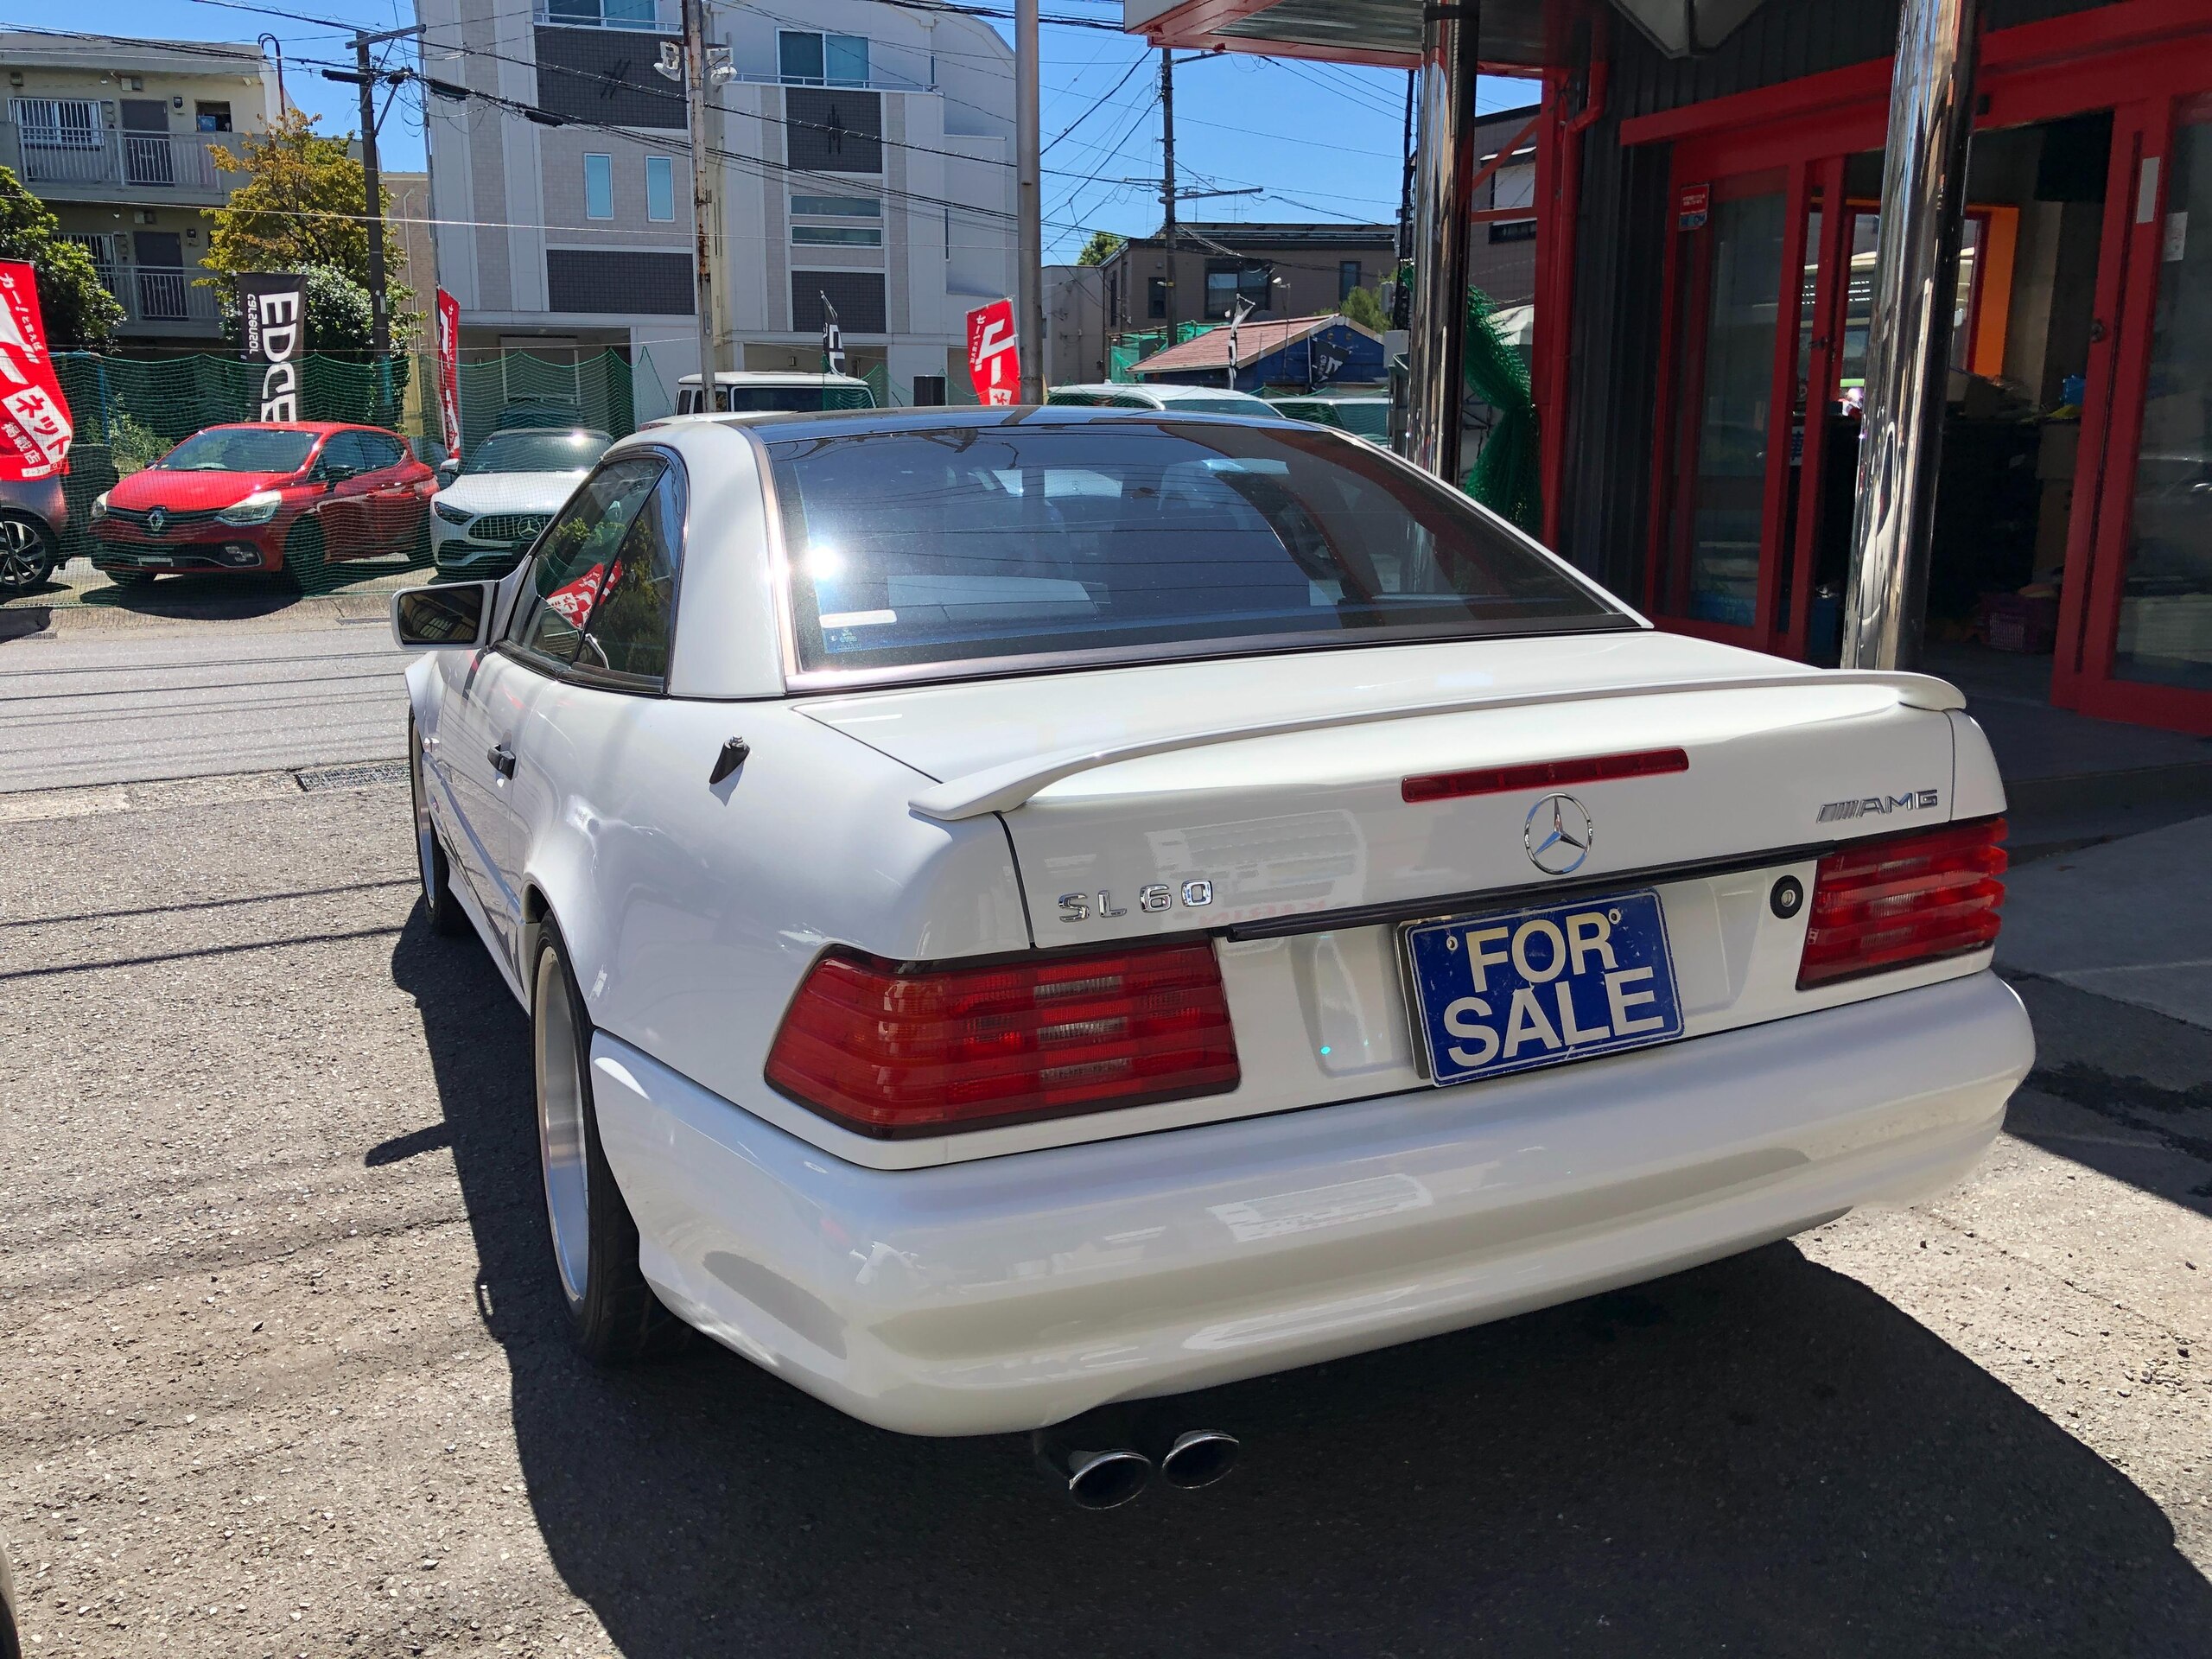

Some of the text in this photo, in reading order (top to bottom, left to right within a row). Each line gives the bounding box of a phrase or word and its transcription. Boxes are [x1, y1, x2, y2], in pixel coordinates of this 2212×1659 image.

[1, 422, 41, 465] 掲載店
[16, 394, 71, 455] ネット
[1855, 789, 1938, 817] AMG
[1465, 912, 1619, 993] FOR
[1443, 965, 1664, 1067] SALE
